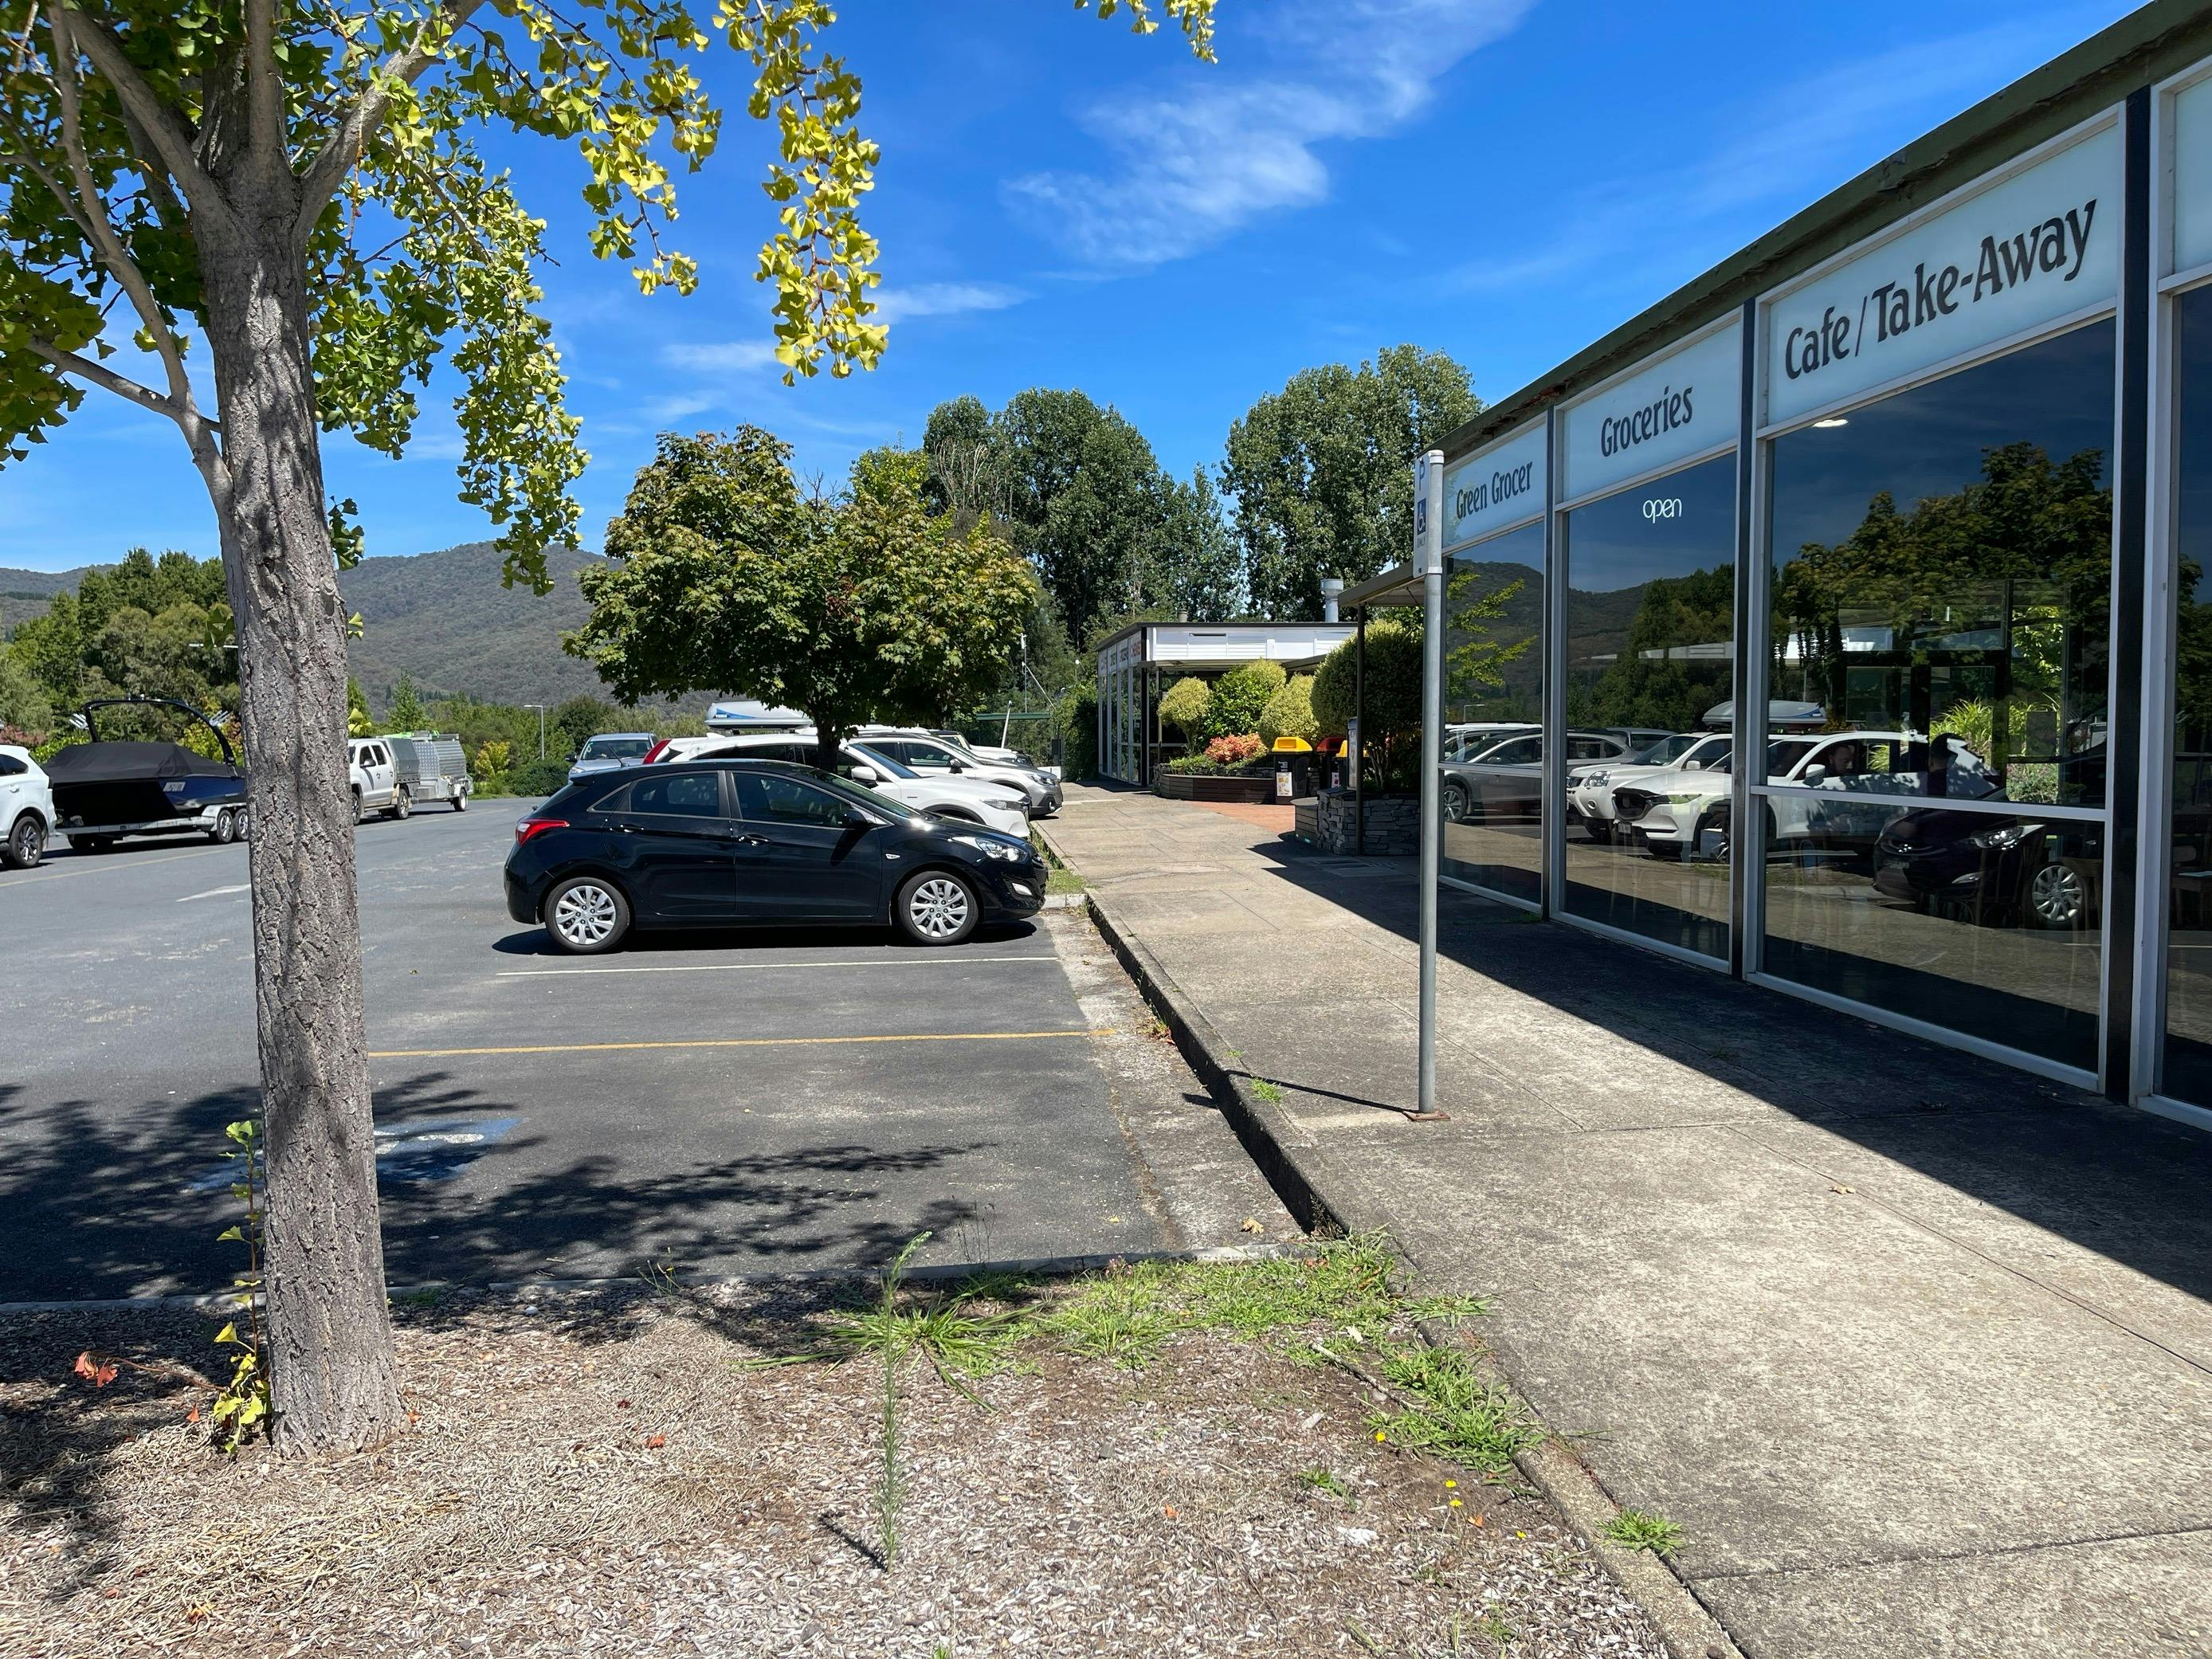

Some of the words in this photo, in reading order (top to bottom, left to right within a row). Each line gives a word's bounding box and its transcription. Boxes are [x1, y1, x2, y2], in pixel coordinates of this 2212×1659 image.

[1785, 198, 2097, 380] Cafe/Take-Away
[1601, 385, 1693, 457] Groceries
[1418, 457, 1426, 492] P
[1456, 483, 1488, 520] Green
[1491, 461, 1533, 504] Grocer
[1642, 498, 1682, 524] open
